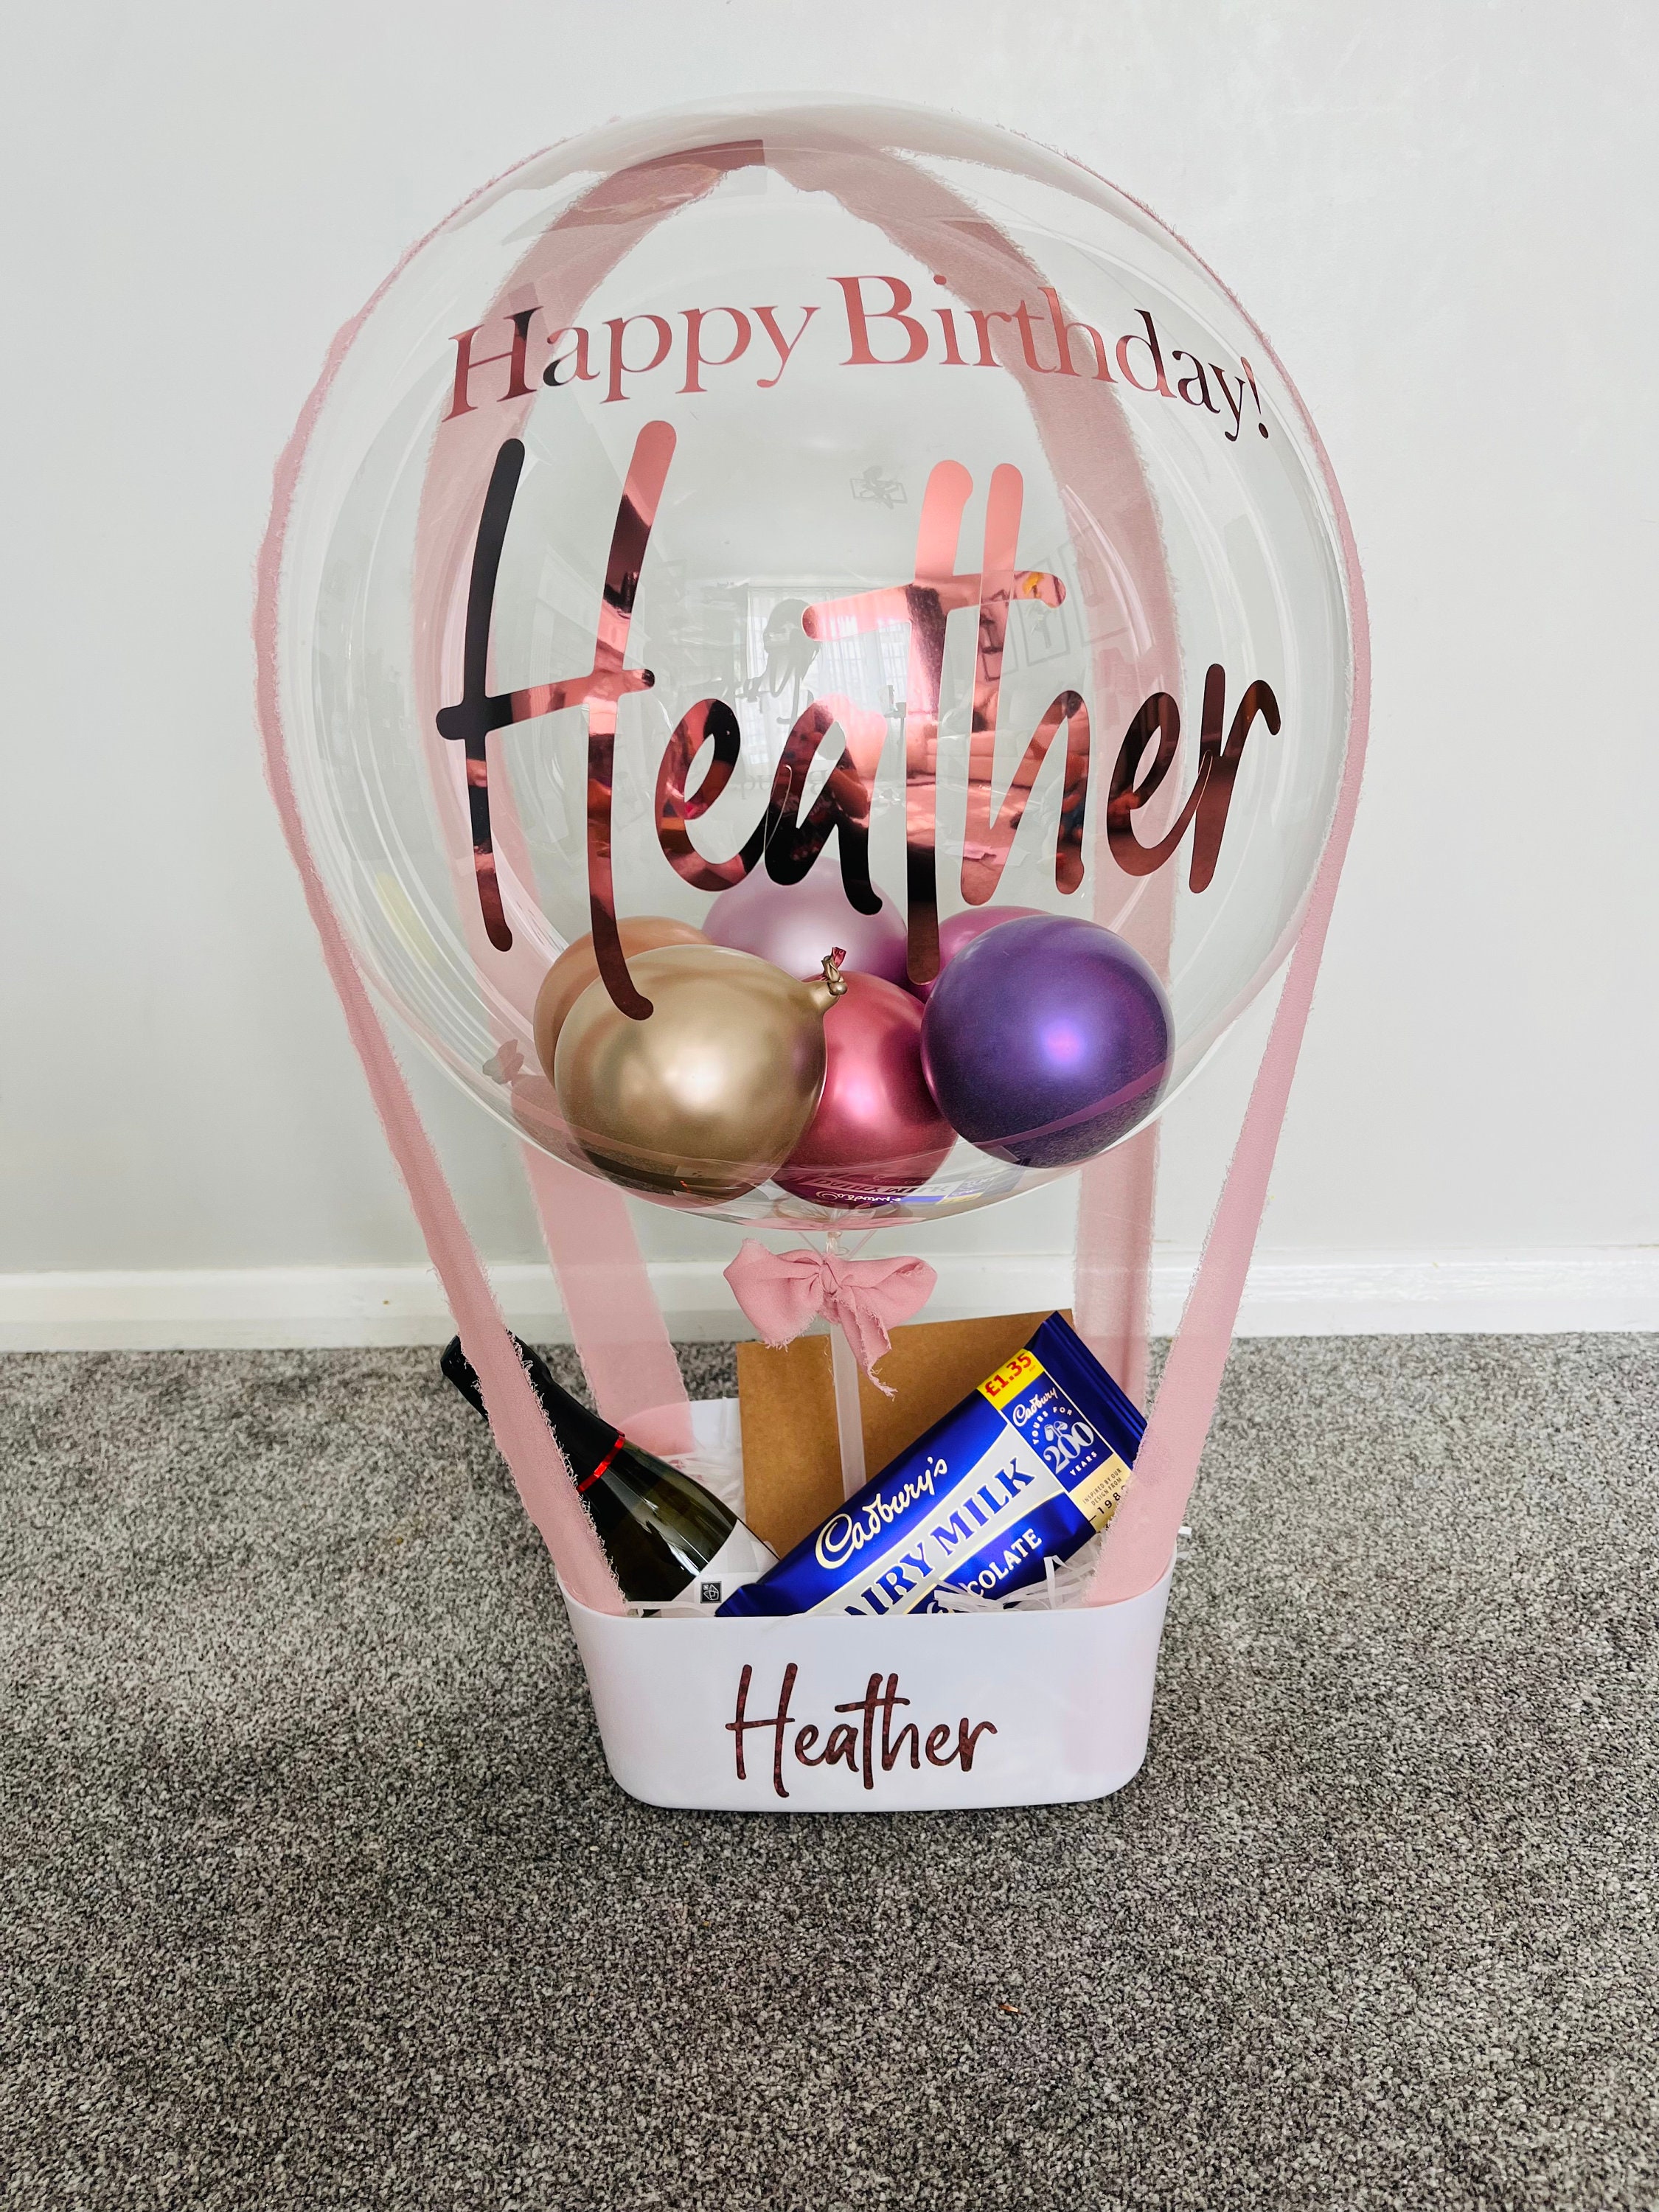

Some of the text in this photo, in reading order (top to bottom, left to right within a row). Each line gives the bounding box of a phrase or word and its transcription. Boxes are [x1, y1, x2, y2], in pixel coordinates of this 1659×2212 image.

[442, 275, 1270, 442] Happy Birthday!
[435, 420, 1281, 1020] Heather
[984, 1353, 1032, 1397] £1.35
[1013, 1387, 1059, 1427] Cadbury
[1032, 1406, 1073, 1444] YOURS FOR
[1043, 1422, 1094, 1474] 200
[1070, 1451, 1097, 1475] YEARS
[930, 1457, 1035, 1556] MILK
[1082, 1468, 1121, 1504] INSPIRED BY OUR
[1091, 1477, 1121, 1506] DESIGN FROM
[815, 1457, 948, 1570] Cadbury's
[967, 1528, 1043, 1598] COLATE
[725, 1662, 998, 1798] Heather
